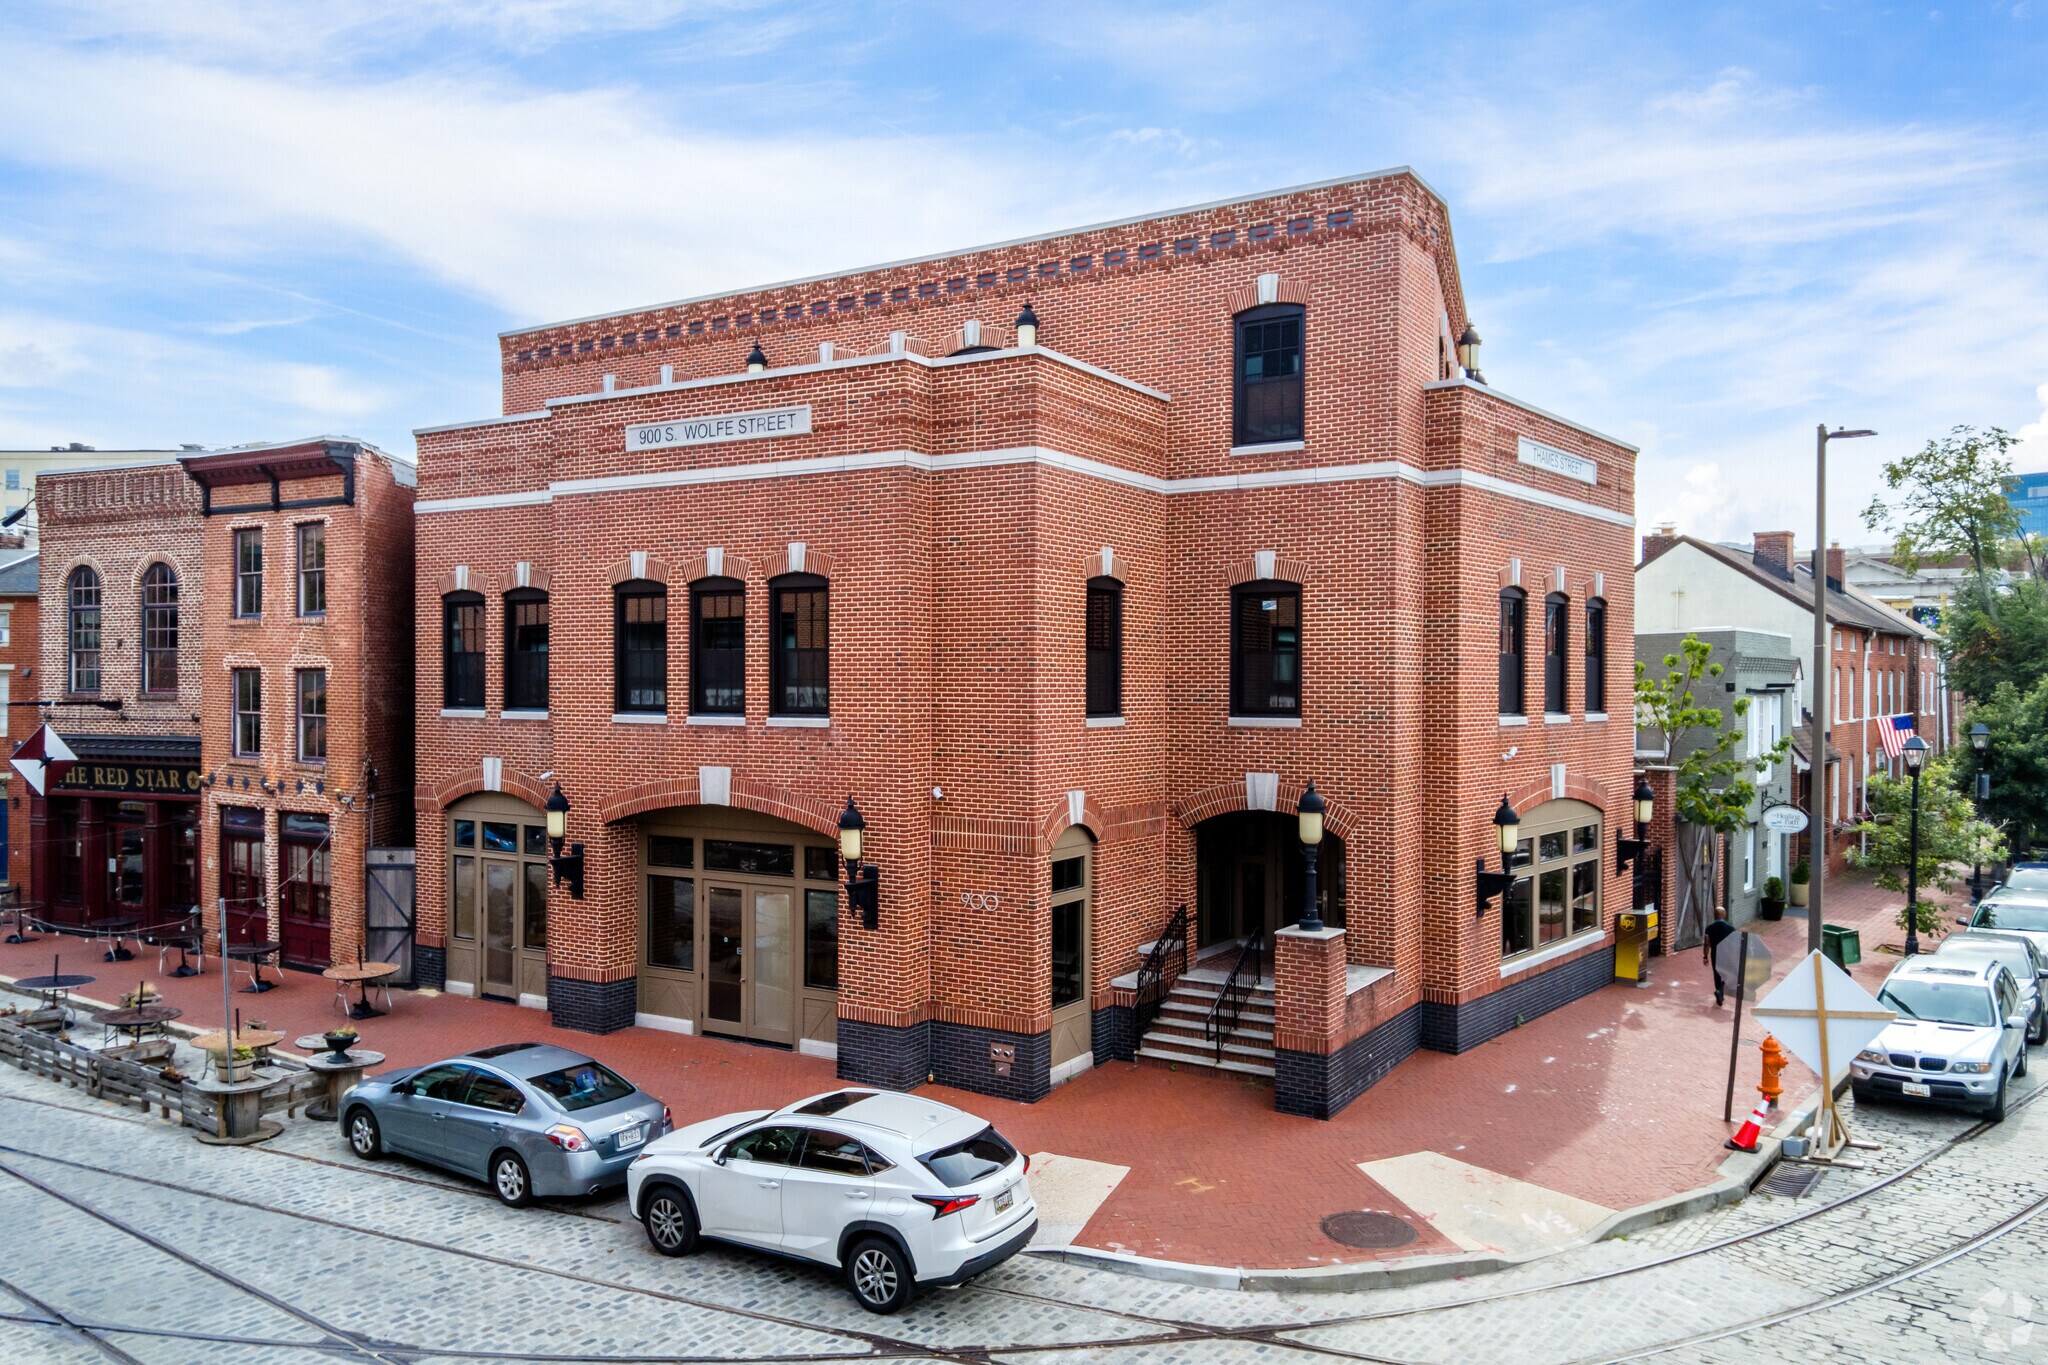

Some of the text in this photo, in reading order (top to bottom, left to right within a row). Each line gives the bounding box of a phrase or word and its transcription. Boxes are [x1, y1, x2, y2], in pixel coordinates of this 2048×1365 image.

[639, 412, 796, 445] 900 S. WOLFE STREET
[1532, 447, 1583, 476] THAMES STREET
[65, 766, 180, 789] HE RED STAR
[961, 892, 999, 912] 900
[1621, 919, 1636, 929] ups
